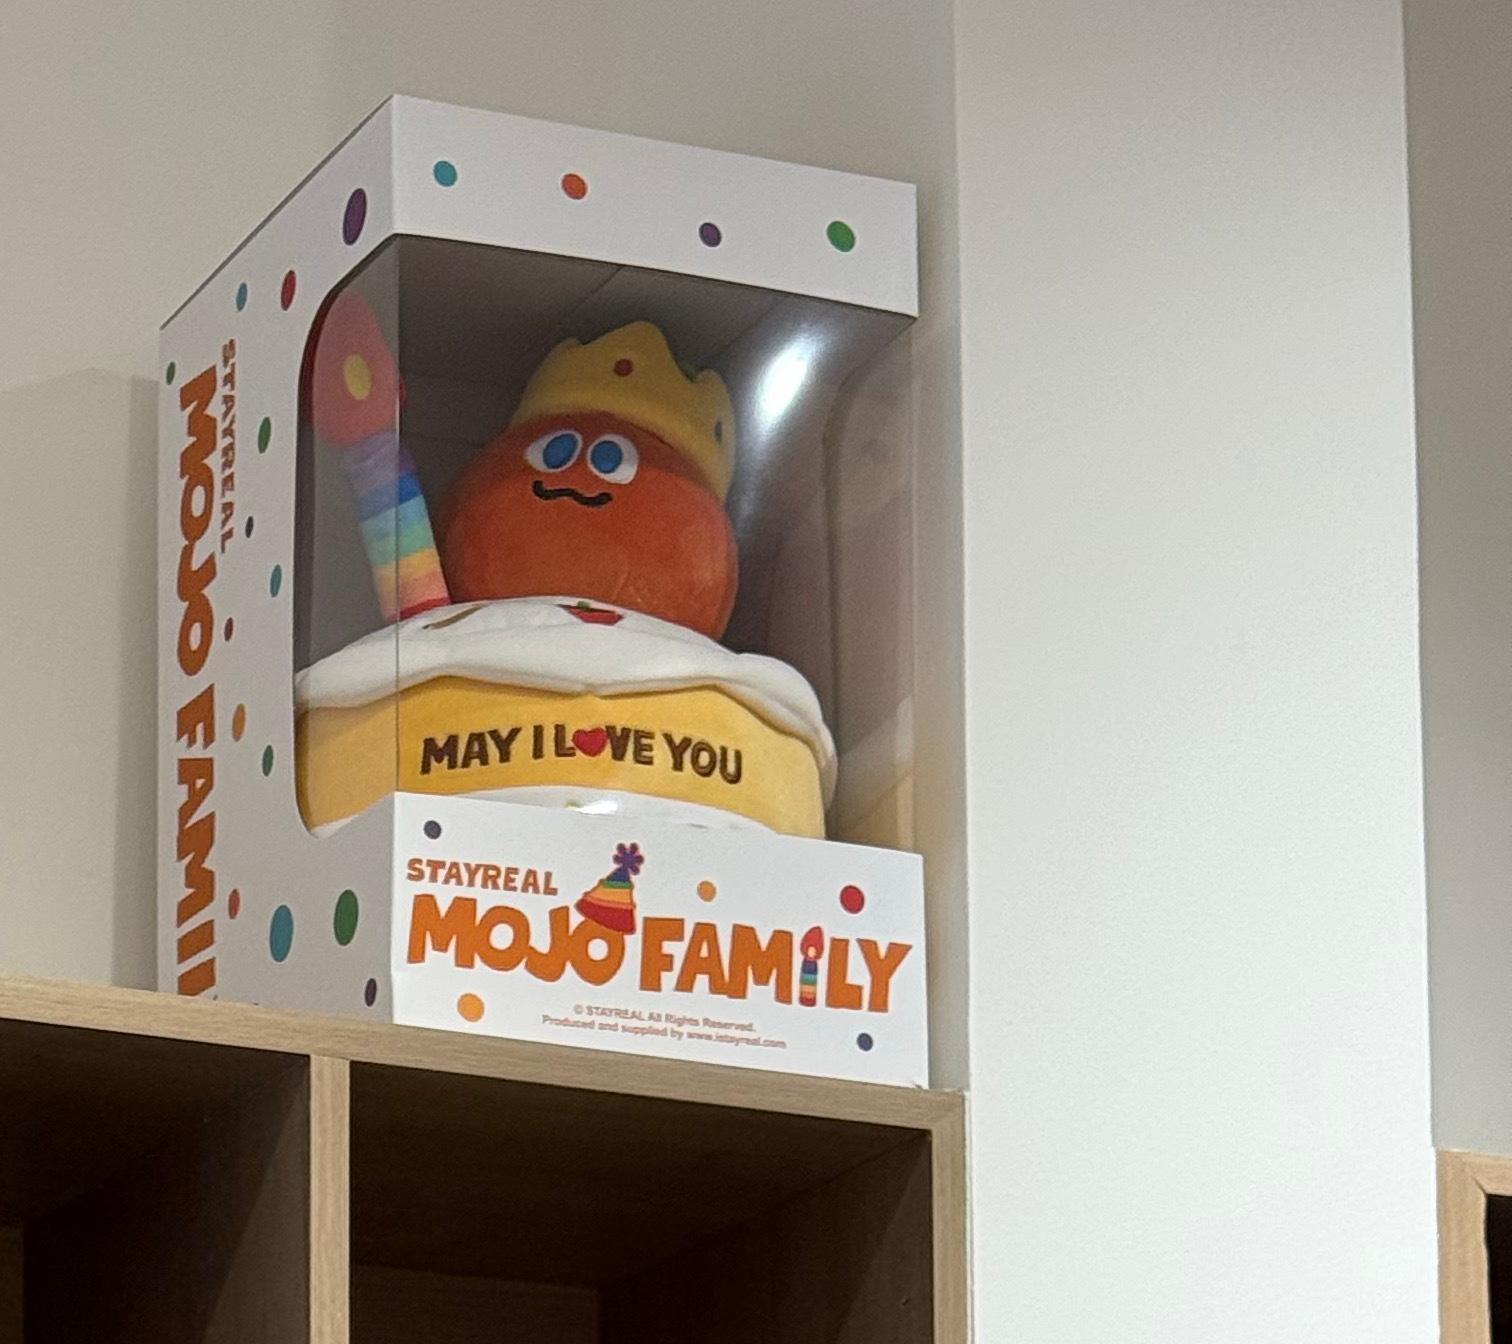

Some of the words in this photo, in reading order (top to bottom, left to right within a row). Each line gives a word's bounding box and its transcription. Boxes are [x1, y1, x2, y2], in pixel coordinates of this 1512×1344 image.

[219, 338, 237, 555] STAYREAL
[177, 364, 218, 677] MOJO
[420, 726, 522, 775] MAY
[531, 724, 544, 760] I
[662, 732, 743, 785] YOU
[176, 683, 217, 998] FAMIL
[406, 857, 559, 897] STAYREAL
[406, 893, 626, 987] MOJO
[639, 916, 913, 1013] FAMILY
[541, 1014, 595, 1030] Produced
[597, 1022, 619, 1032] and
[620, 1024, 668, 1037] supplied
[669, 1027, 684, 1040] by
[586, 1005, 646, 1021] STAYREAL
[647, 1011, 662, 1023] All
[664, 1013, 700, 1028] Rights
